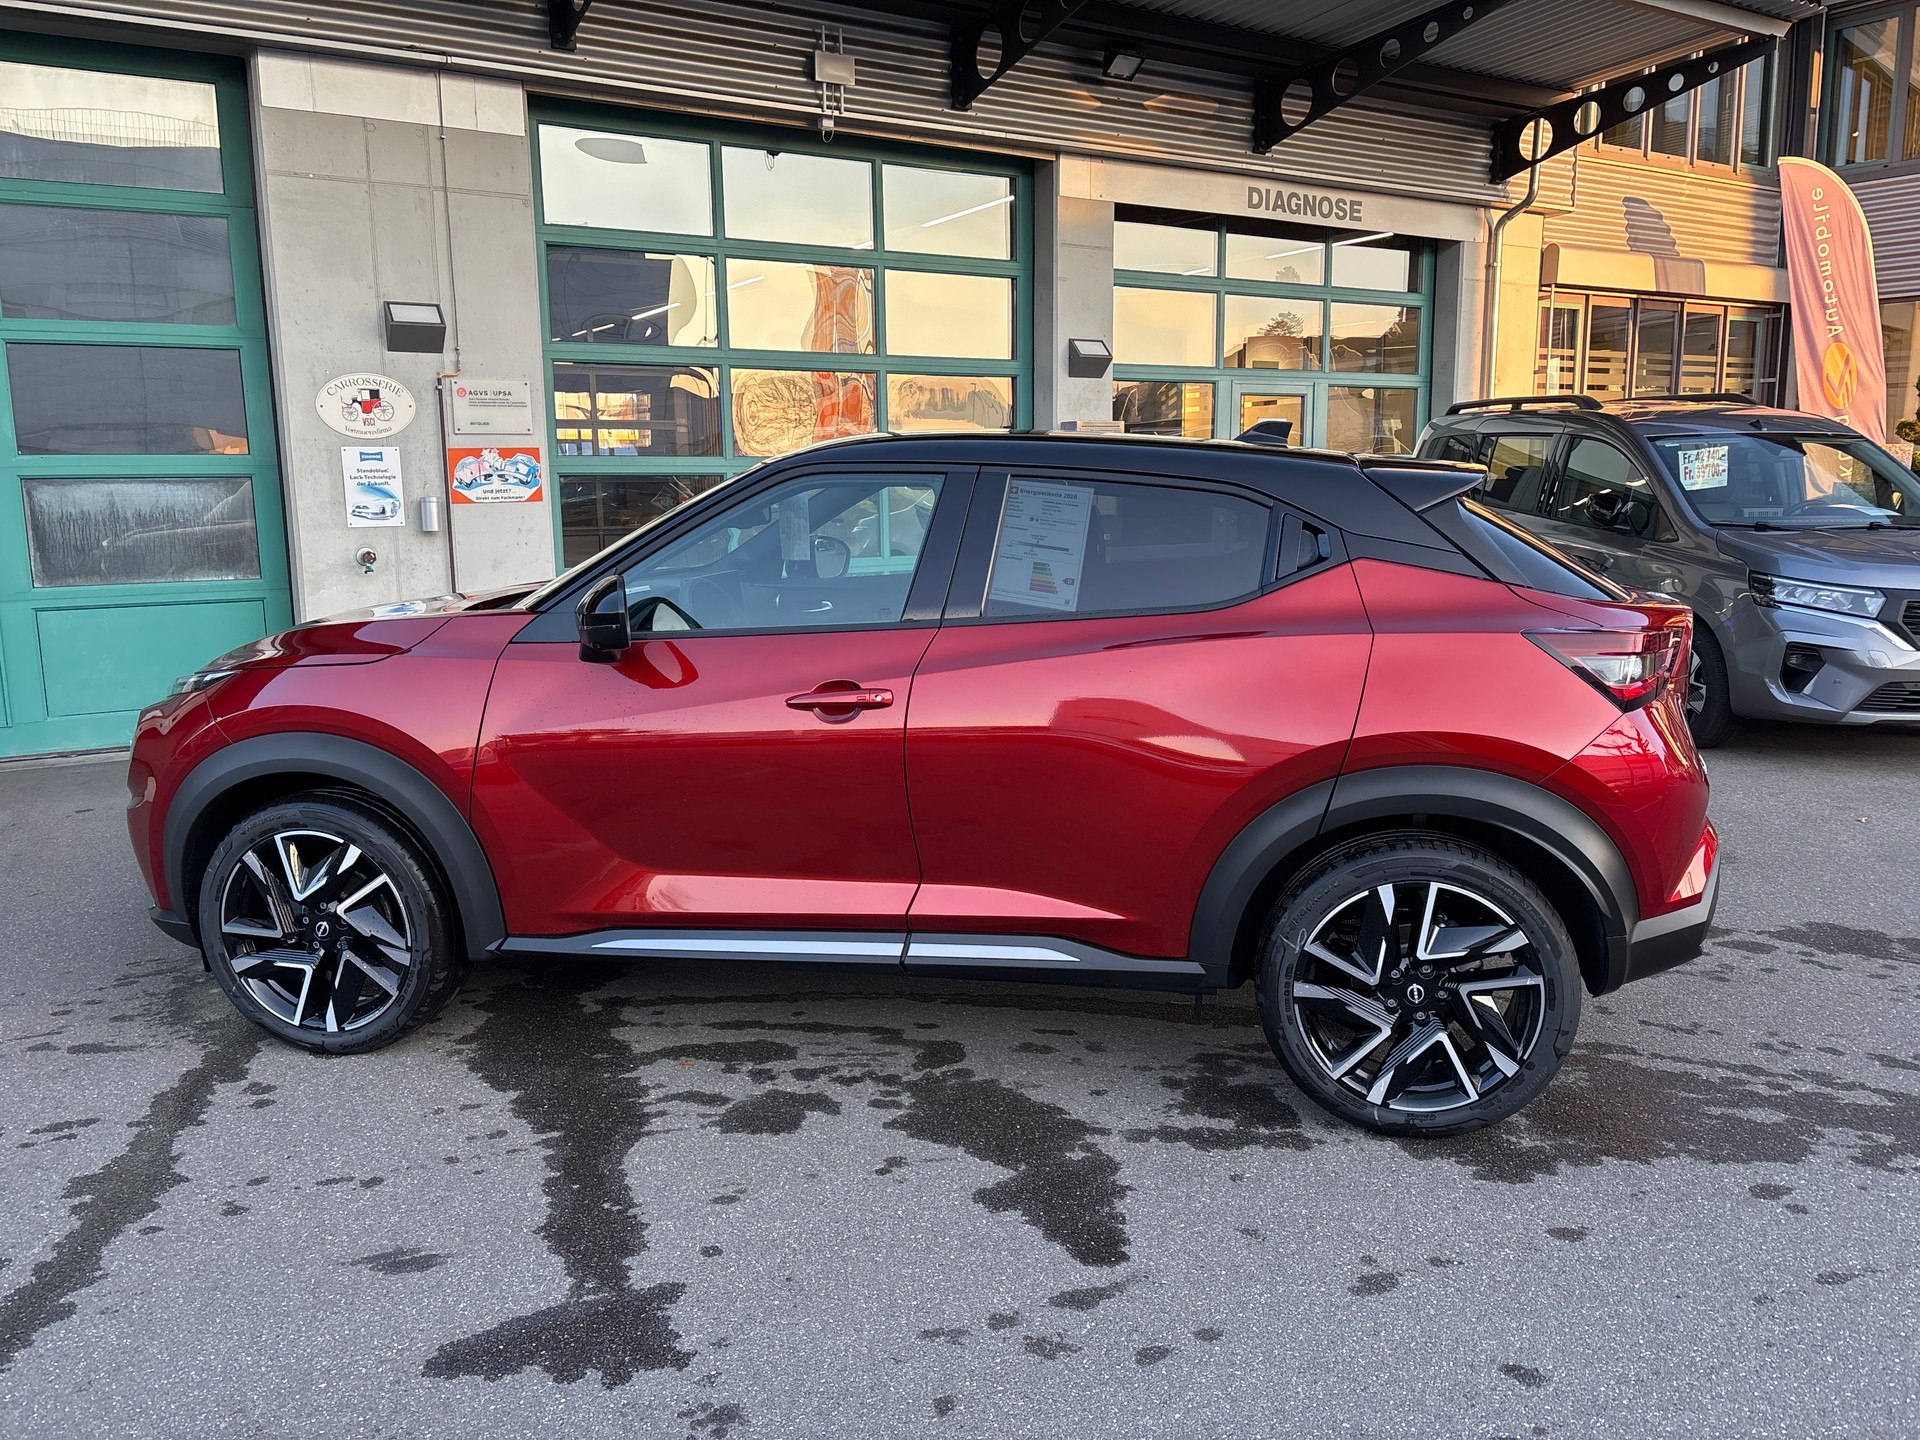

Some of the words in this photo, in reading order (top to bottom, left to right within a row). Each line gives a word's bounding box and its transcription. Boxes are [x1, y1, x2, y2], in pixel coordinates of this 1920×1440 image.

[1247, 186, 1362, 222] DIAGNOSE
[326, 377, 404, 397] CARROSSERIE
[362, 417, 375, 427] VSCI
[1682, 452, 1694, 464] Fr.
[1683, 465, 1694, 480] Fr.
